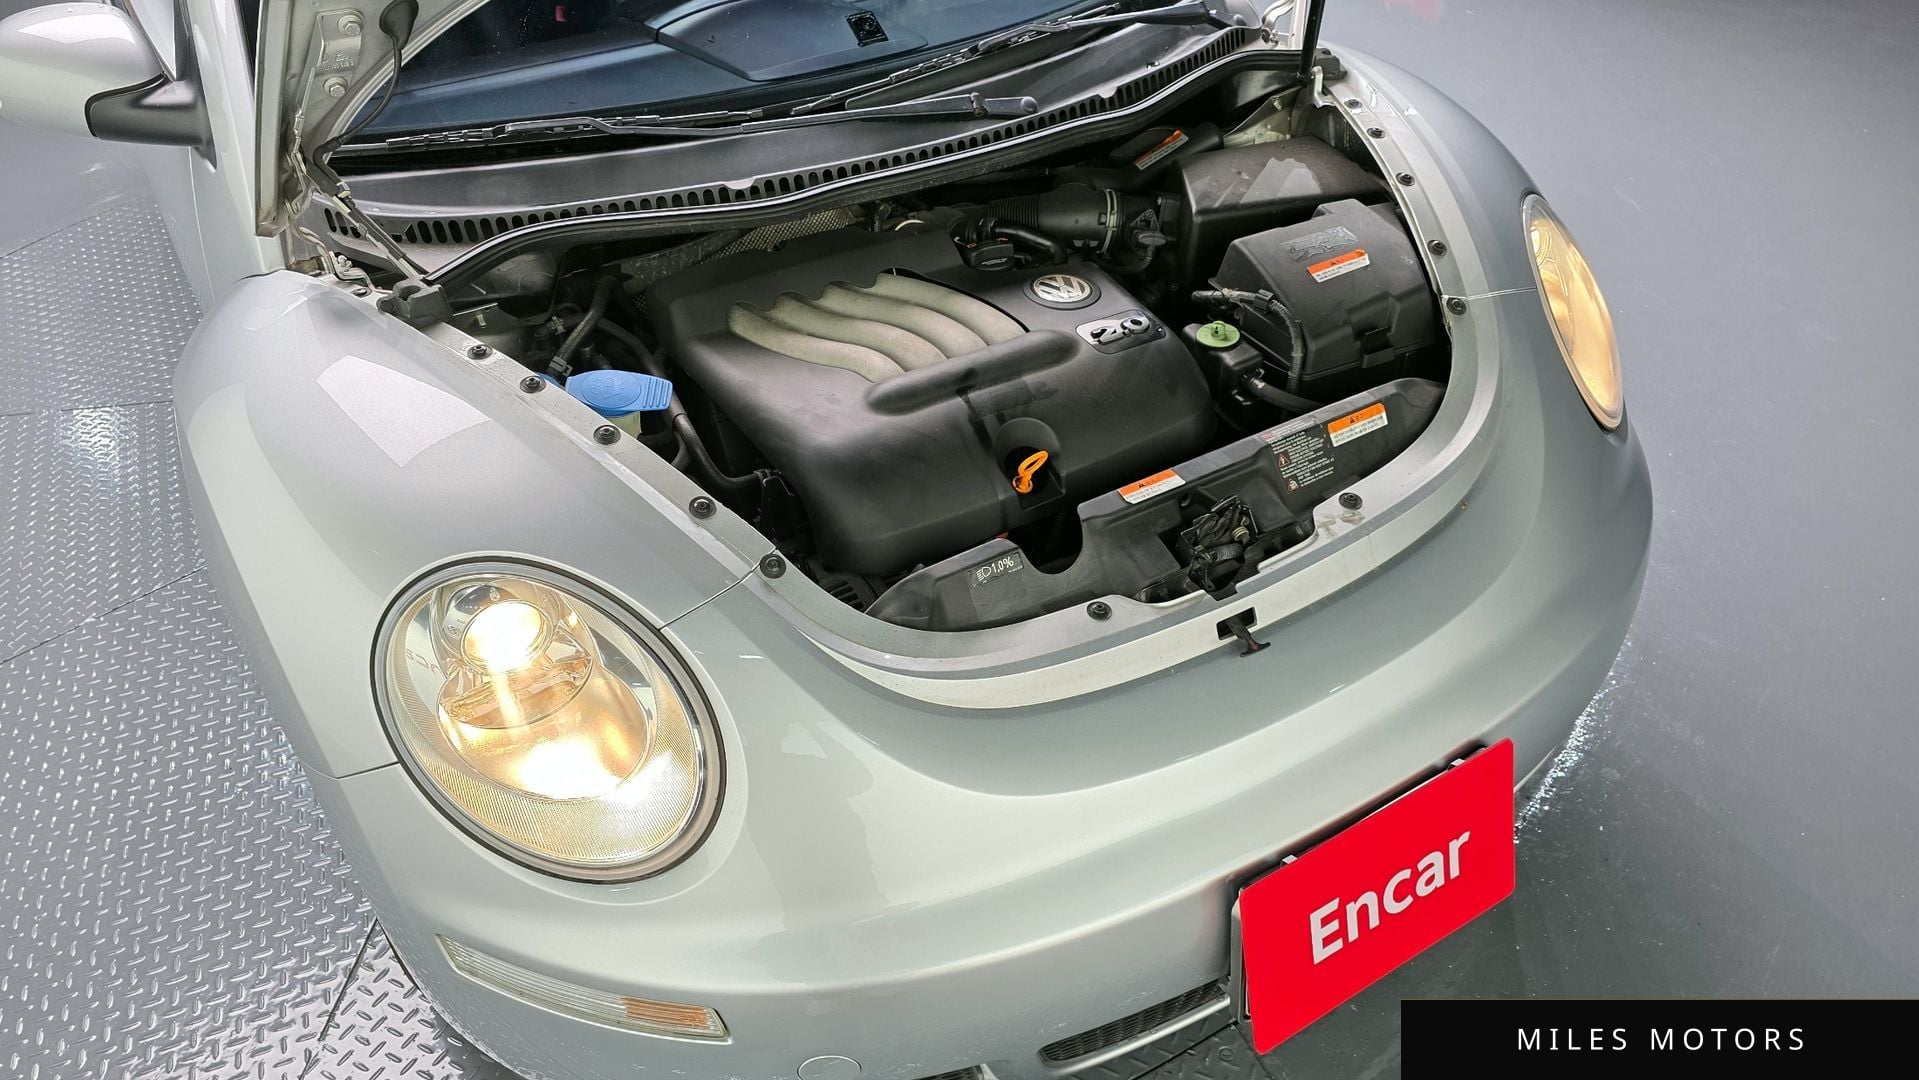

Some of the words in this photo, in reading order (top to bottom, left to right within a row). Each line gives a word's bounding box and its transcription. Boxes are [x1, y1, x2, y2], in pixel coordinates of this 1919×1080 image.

[1091, 314, 1150, 345] 2.0
[991, 556, 1014, 573] 1.0%
[1310, 831, 1471, 965] Encar
